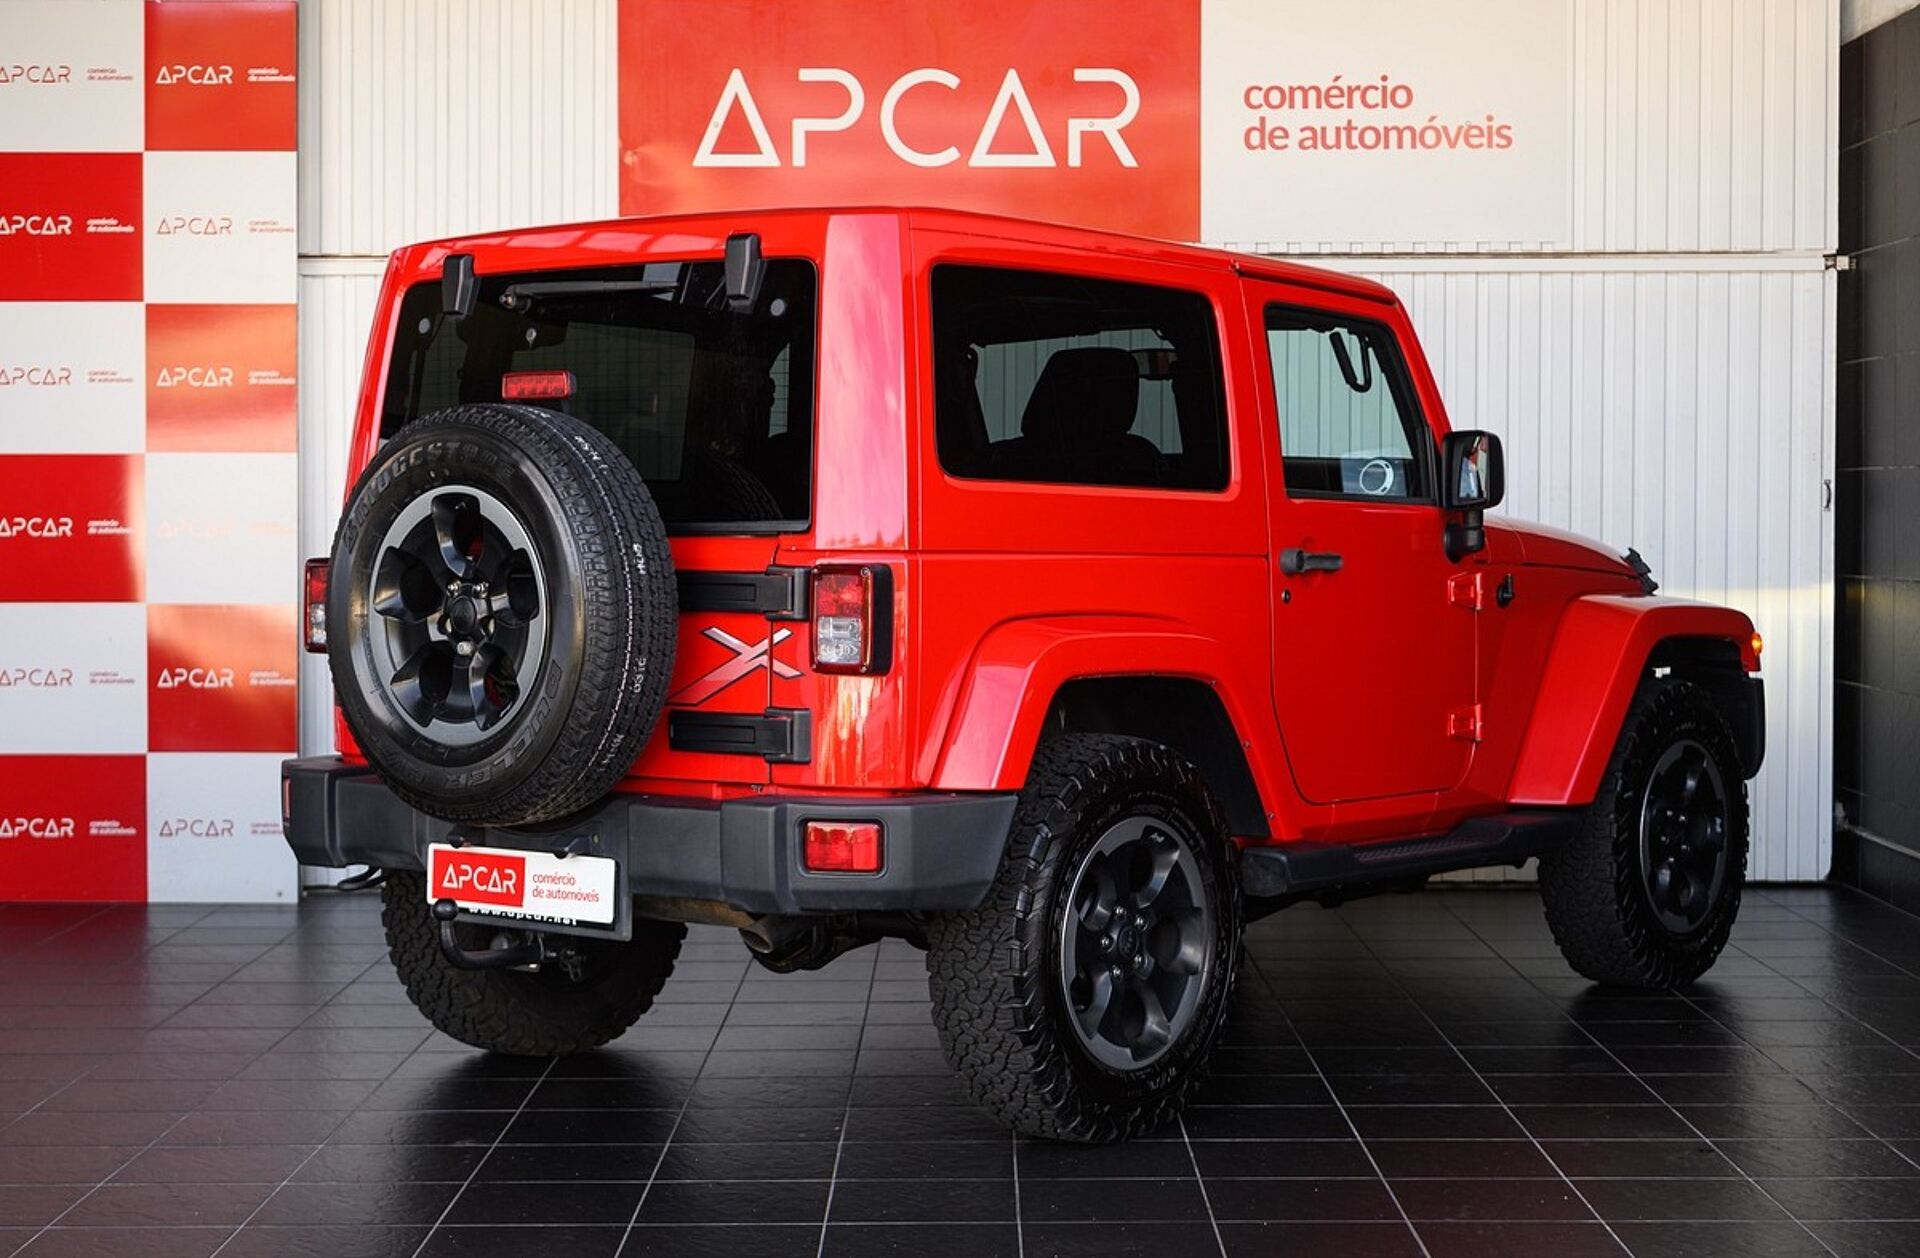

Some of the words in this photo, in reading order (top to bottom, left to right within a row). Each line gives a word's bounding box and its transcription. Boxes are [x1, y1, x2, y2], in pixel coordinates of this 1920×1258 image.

[0, 65, 71, 83] APCAR
[155, 65, 233, 84] APCAR
[1243, 74, 1413, 110] comércio
[692, 67, 1141, 168] APCAR
[1243, 116, 1290, 150] de
[1297, 114, 1513, 150] automóveis
[0, 216, 72, 235] APCAR
[157, 217, 232, 235] APCAR
[0, 367, 72, 385] APCAR
[156, 367, 234, 387] APCAR
[0, 517, 73, 537] APCAR
[0, 668, 73, 686] APCAR
[157, 668, 234, 688] APCAR
[0, 818, 74, 838] APCAR
[159, 819, 234, 837] APCAR
[441, 862, 517, 895] APCAR
[532, 871, 576, 886] comércio
[532, 886, 545, 899] de
[546, 888, 600, 903] automóveis
